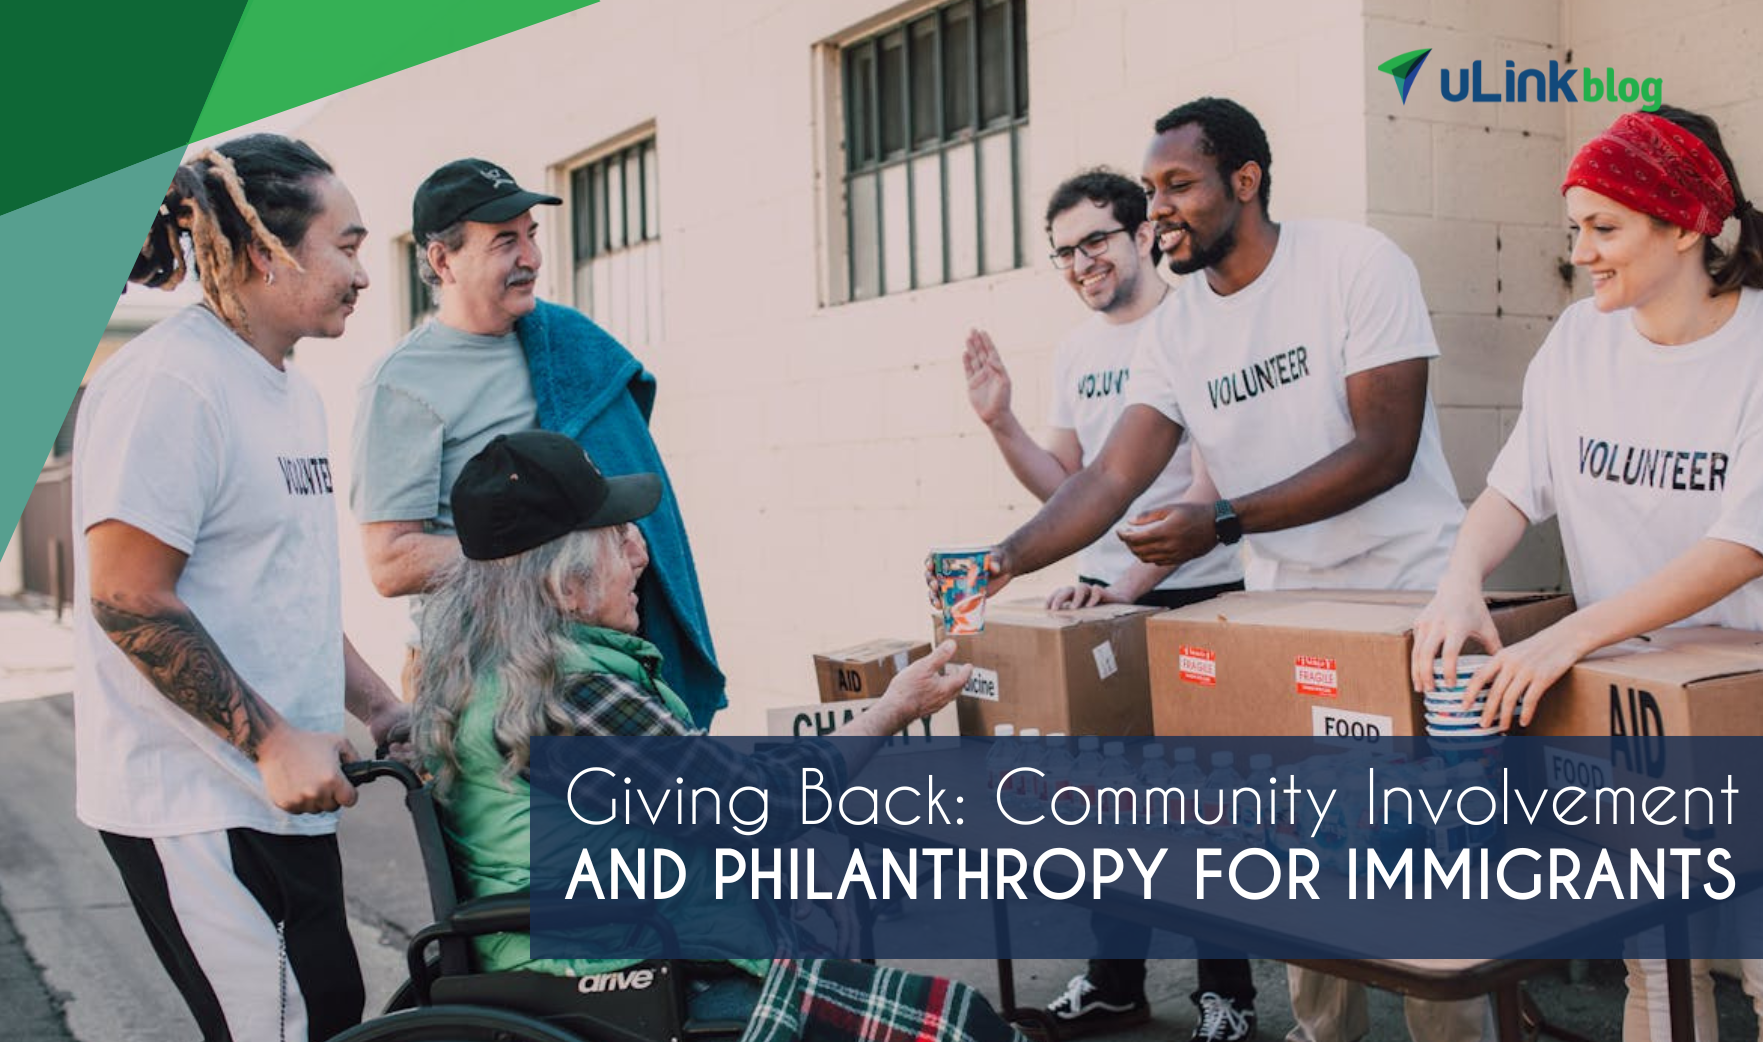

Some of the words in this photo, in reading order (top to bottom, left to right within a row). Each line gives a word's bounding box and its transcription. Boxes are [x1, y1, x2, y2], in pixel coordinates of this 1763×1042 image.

[1207, 346, 1310, 408] VOLUNTEER
[278, 457, 333, 495] VOLUNTE
[1579, 436, 1729, 491] VOLUNTEER
[838, 669, 862, 692] AID
[1324, 716, 1380, 744] FOOD
[1610, 684, 1666, 779] AID
